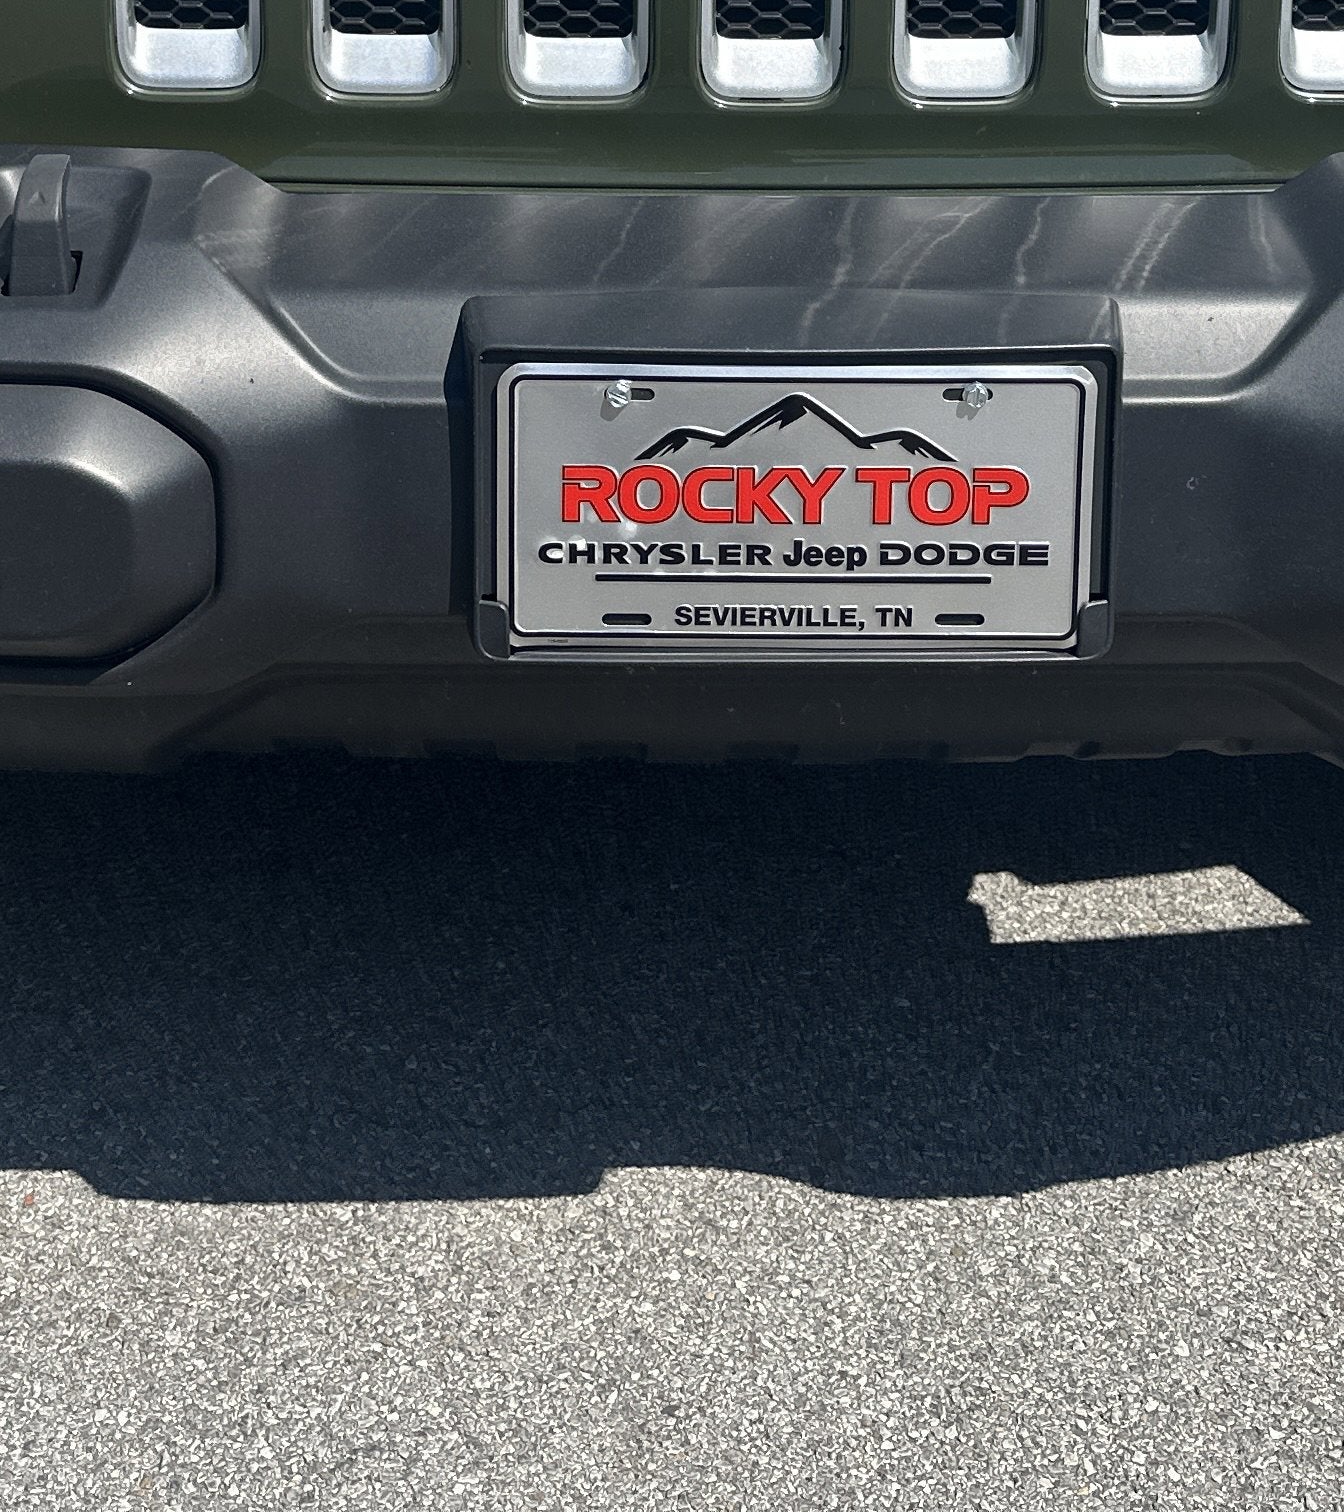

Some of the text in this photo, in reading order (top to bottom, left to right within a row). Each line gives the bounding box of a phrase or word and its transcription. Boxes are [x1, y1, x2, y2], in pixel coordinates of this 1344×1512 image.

[561, 464, 1031, 526] ROCKY TOP
[538, 539, 1050, 571] CHRYSLER Jeep DODGE
[674, 605, 914, 632] SEVIERVILLE, TN
